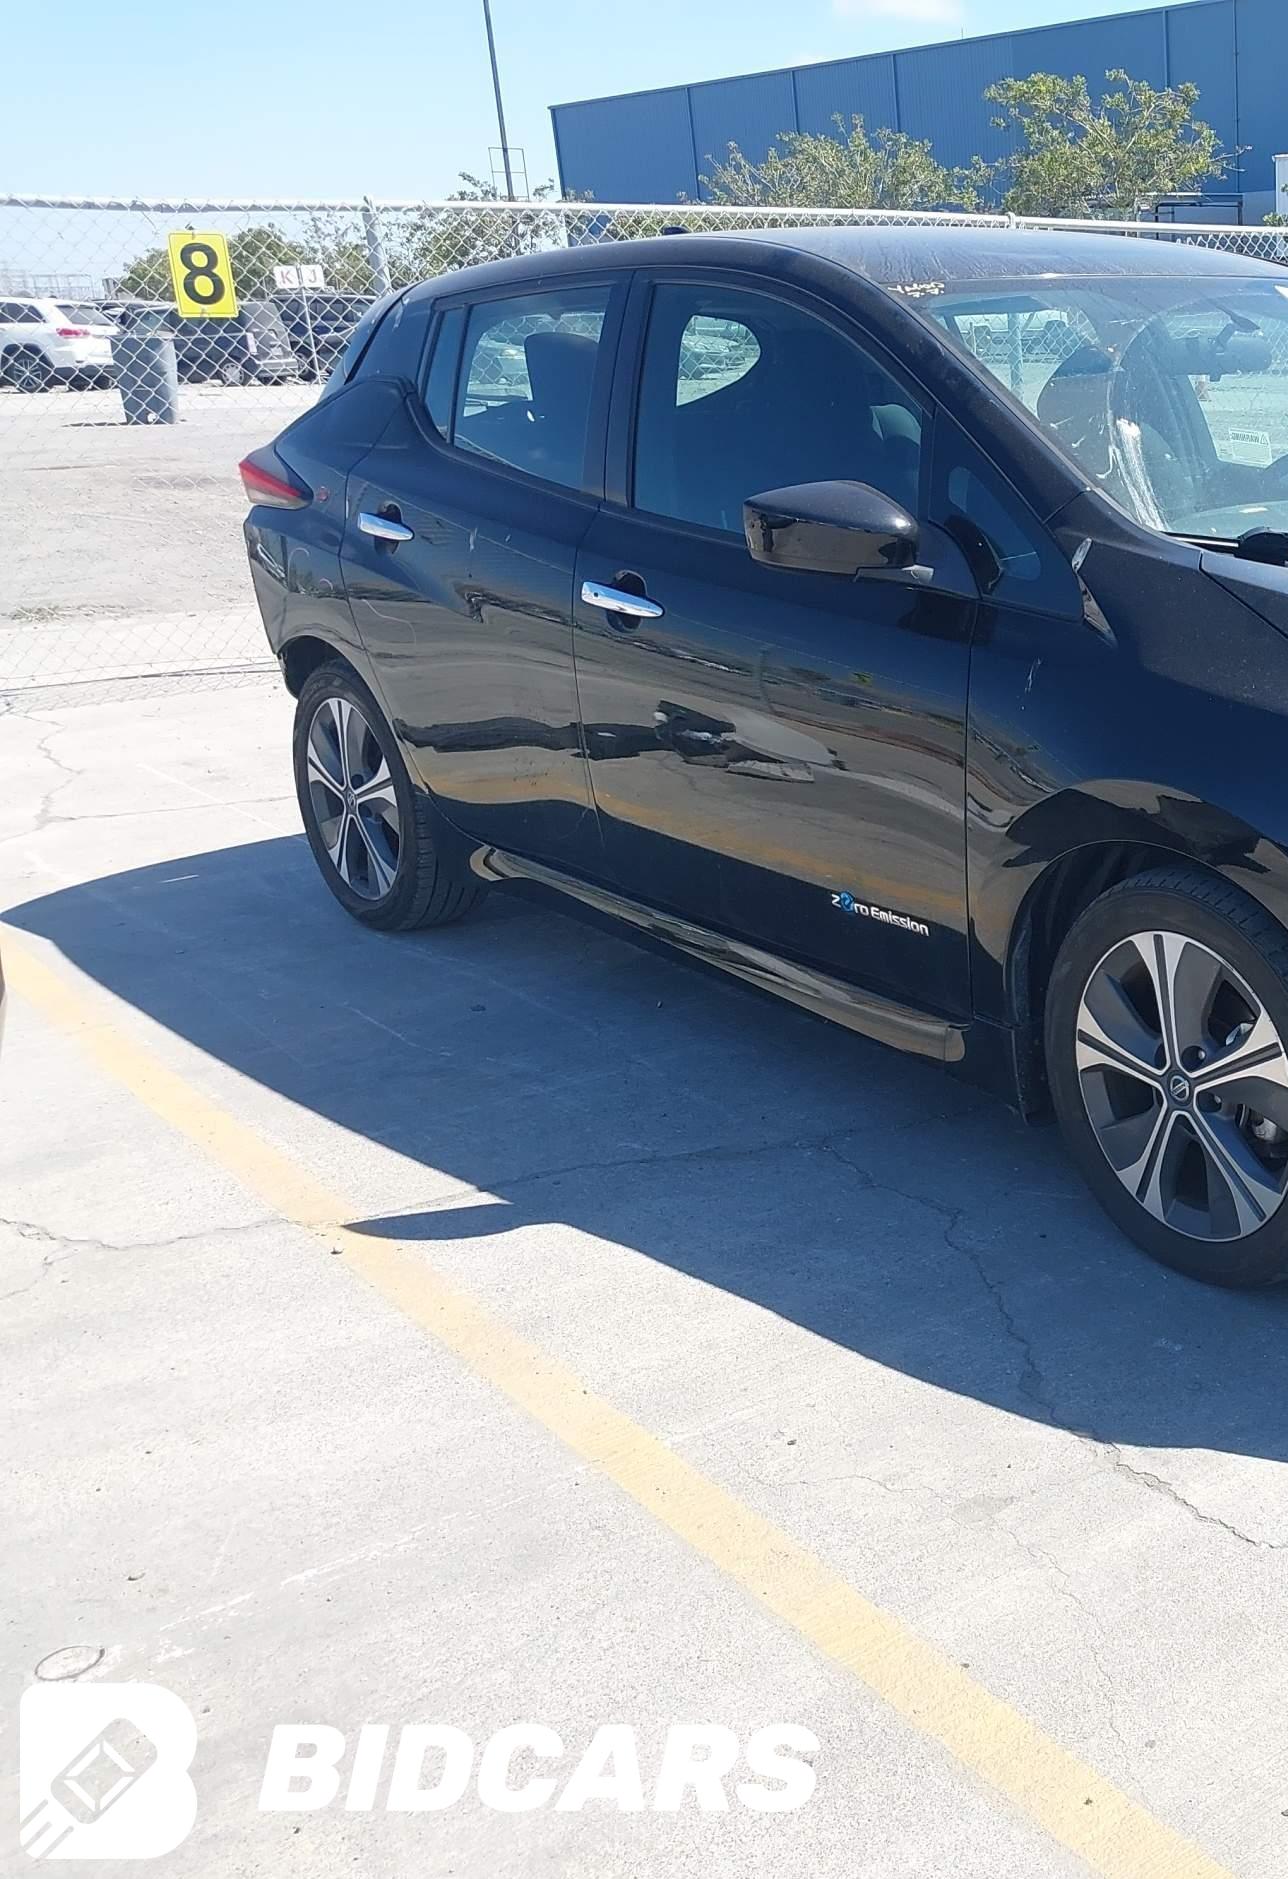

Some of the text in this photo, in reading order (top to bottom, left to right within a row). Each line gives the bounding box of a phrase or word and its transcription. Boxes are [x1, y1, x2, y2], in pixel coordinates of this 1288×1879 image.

[180, 242, 225, 305] 8
[281, 270, 294, 284] K
[308, 269, 318, 284] J
[870, 906, 929, 936] Emission
